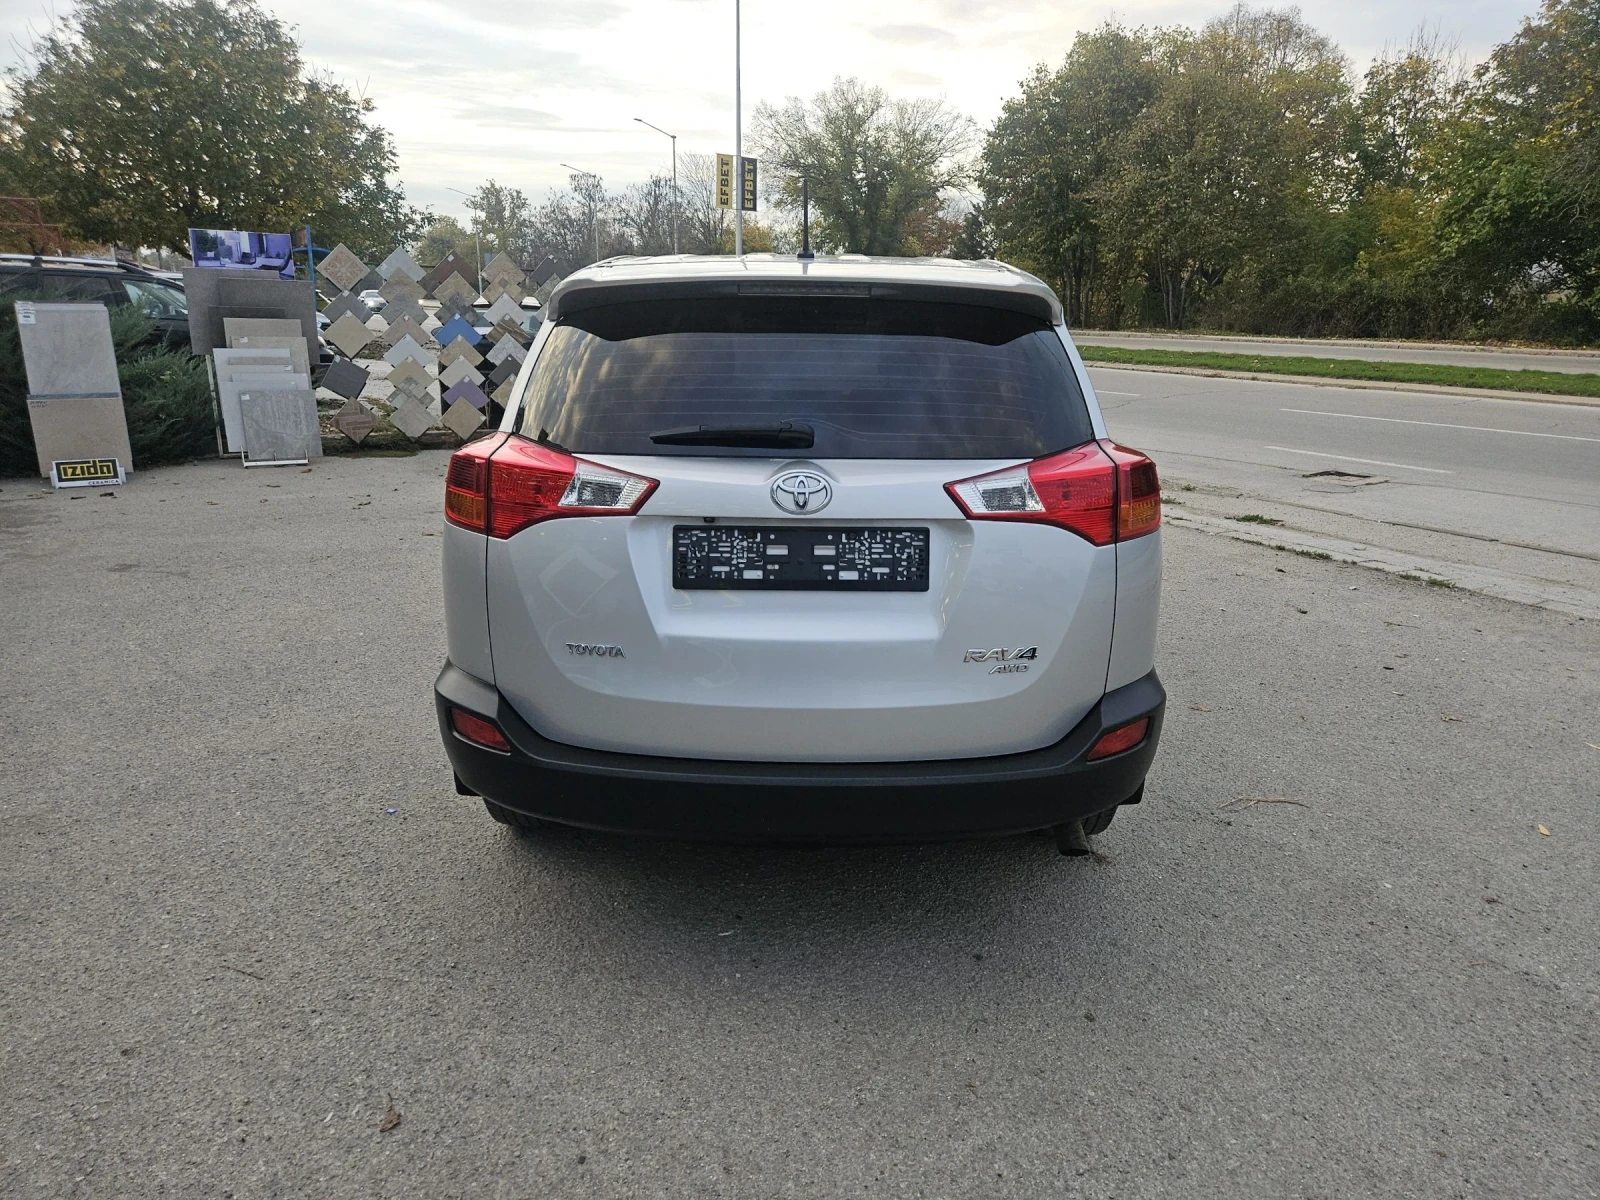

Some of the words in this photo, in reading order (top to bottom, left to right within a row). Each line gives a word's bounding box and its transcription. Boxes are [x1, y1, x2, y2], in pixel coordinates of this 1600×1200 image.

[720, 157, 729, 206] EFBET
[744, 160, 754, 208] EFBET
[565, 642, 626, 658] TOYOTA
[963, 645, 1039, 663] RAV4
[988, 662, 1029, 675] AWD
